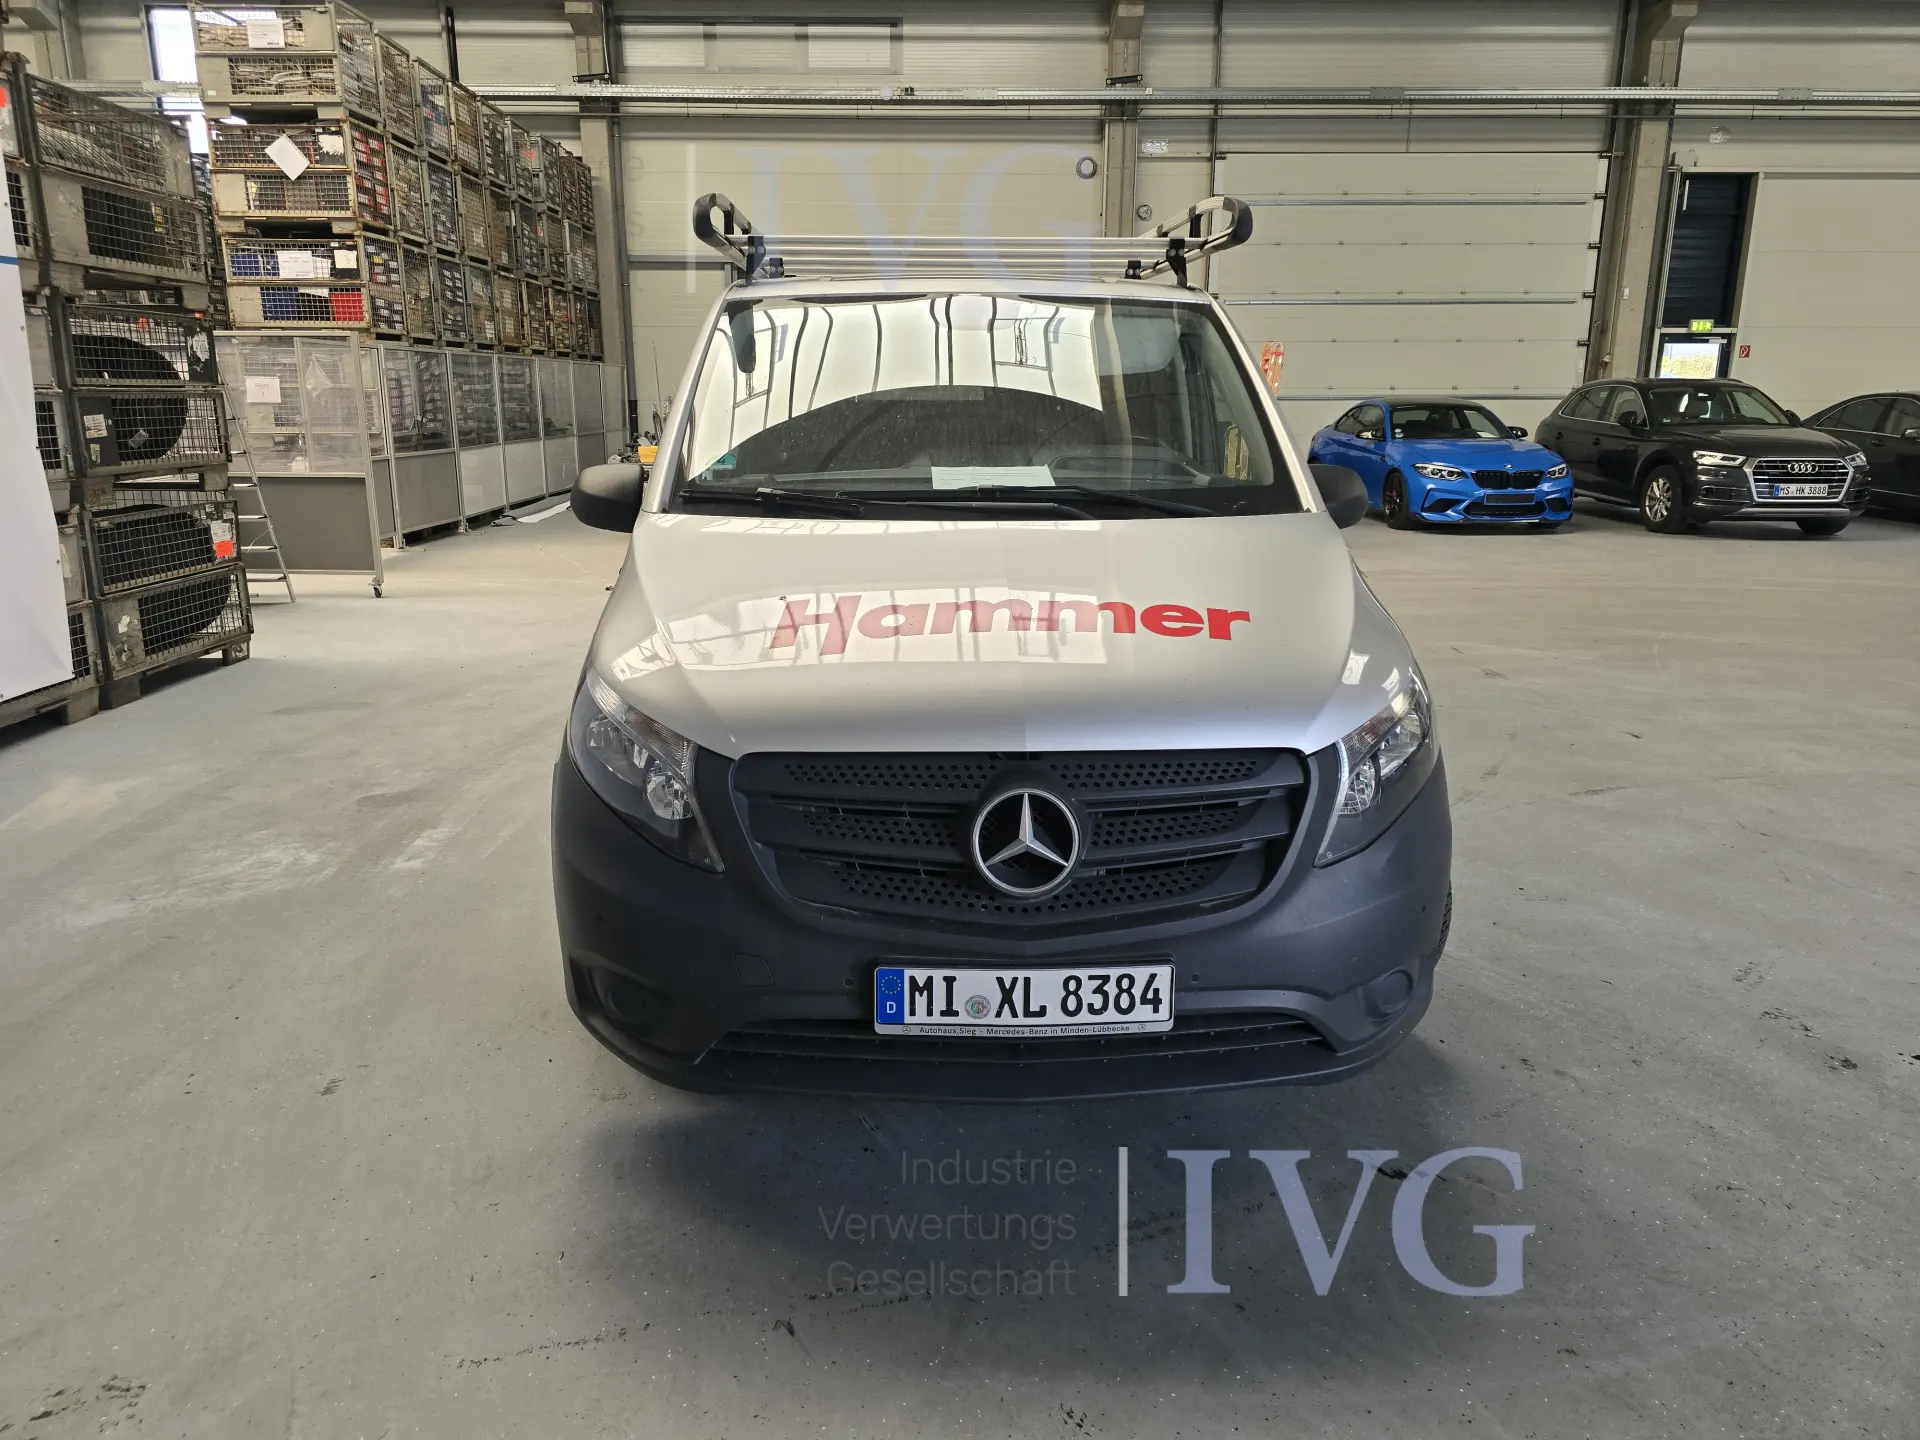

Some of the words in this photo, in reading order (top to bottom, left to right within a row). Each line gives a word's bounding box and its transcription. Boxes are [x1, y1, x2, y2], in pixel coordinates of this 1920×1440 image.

[1780, 486, 1790, 495] MS
[1796, 486, 1806, 494] HK
[1807, 486, 1827, 495] 3888
[768, 595, 1251, 656] Hammer
[886, 1001, 897, 1014] D
[909, 975, 960, 1018] MI
[994, 975, 1048, 1019] XL
[1060, 972, 1163, 1018] 8384
[986, 1027, 1048, 1035] Mercedes-Benz
[1060, 1025, 1130, 1034] Minden-Lübbecke
